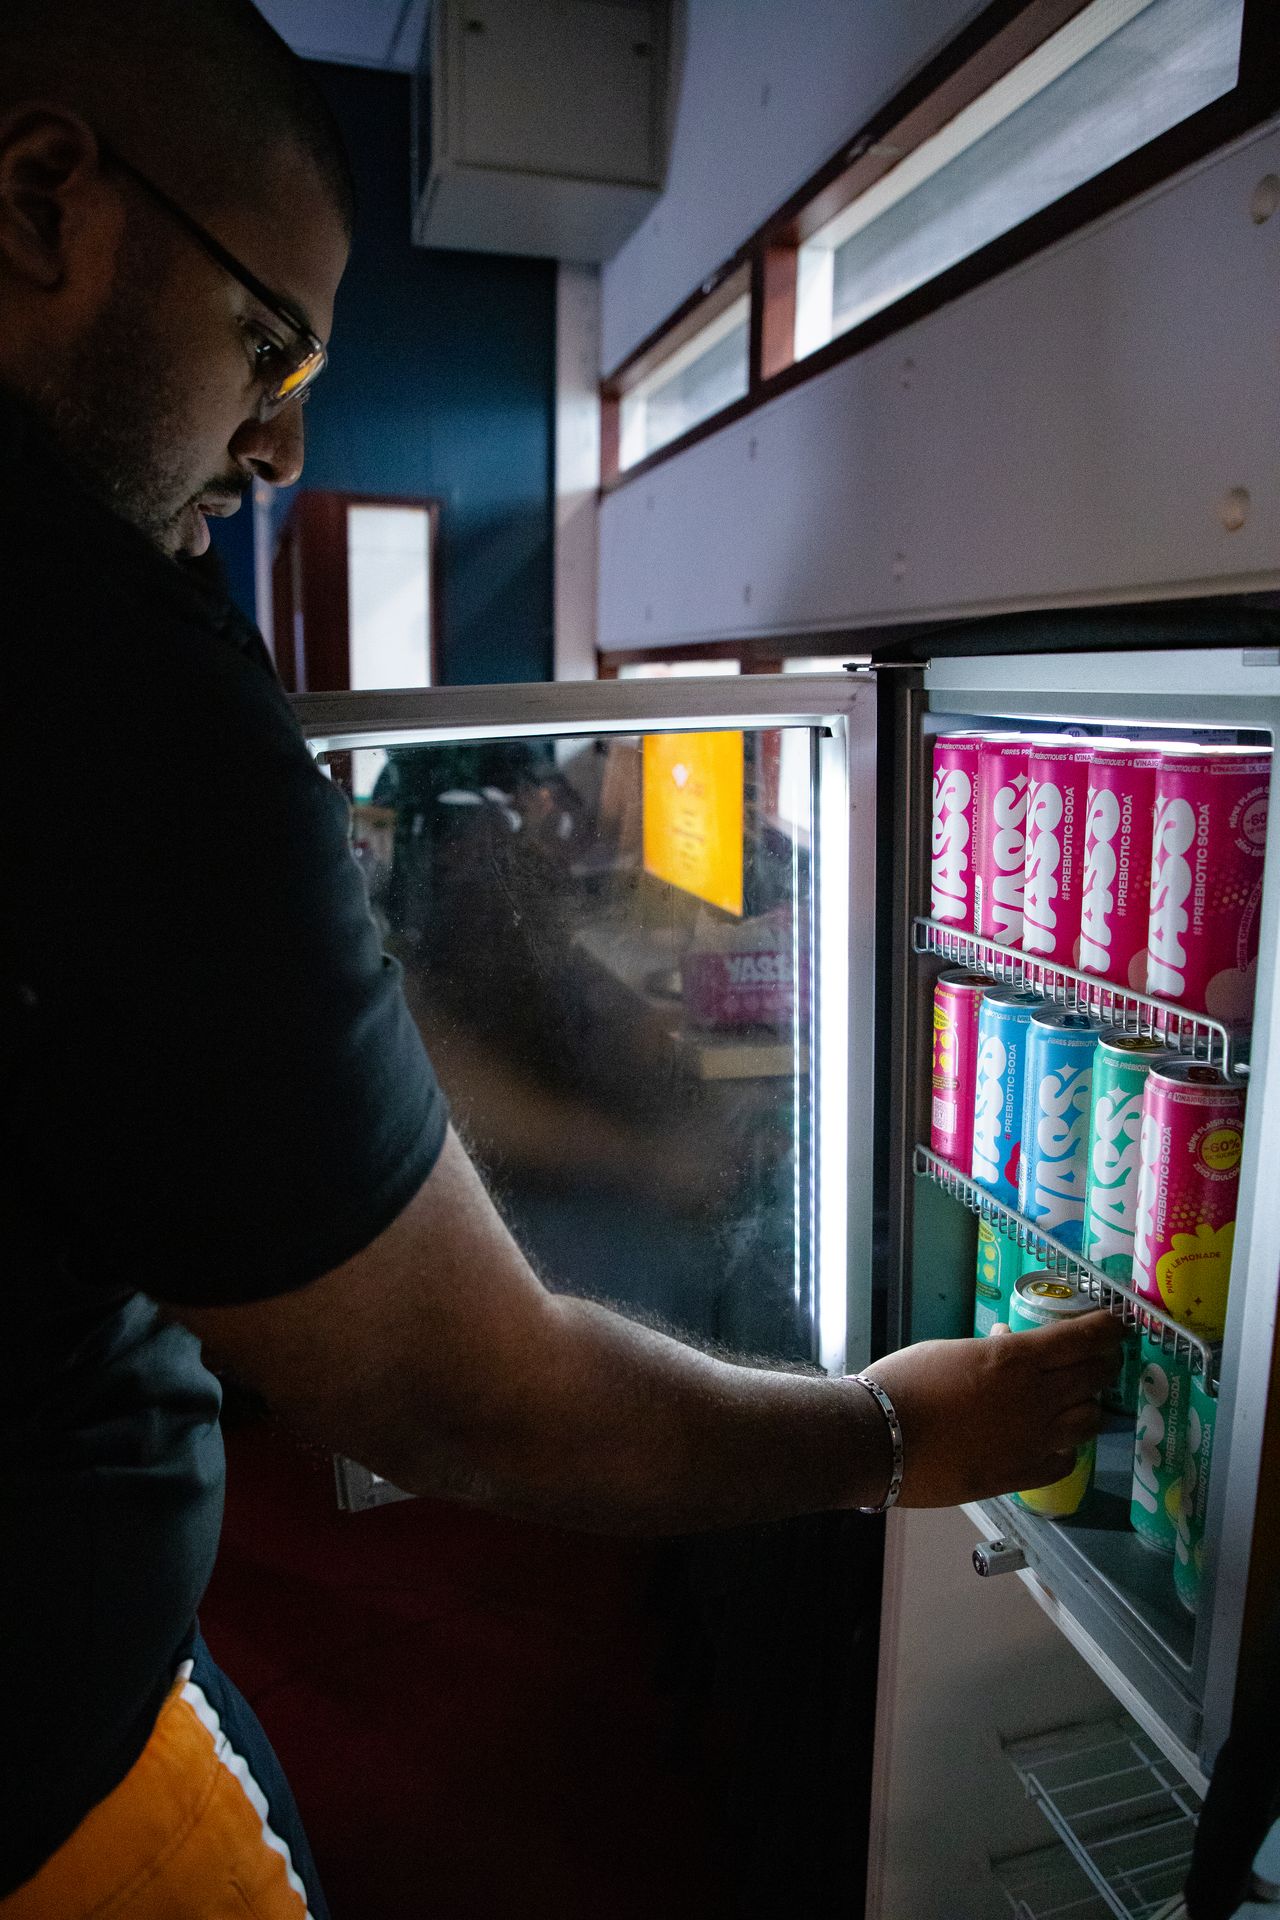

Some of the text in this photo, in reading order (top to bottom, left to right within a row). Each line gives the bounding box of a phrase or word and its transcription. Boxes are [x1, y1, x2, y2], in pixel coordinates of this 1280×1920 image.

[1062, 786, 1075, 901] #PREBIOTIC SODA
[1117, 793, 1134, 917] #PREBIOTIC SODA
[1193, 802, 1211, 936] #PREBIOTIC SODA
[1004, 1043, 1017, 1140] #PREBIOTIC SODA
[1035, 1067, 1093, 1231] YASS
[1089, 1094, 1144, 1262] YASS
[1155, 1125, 1172, 1243] #PREBIOTIC SODA
[1165, 1251, 1221, 1294] PINKY LEMONADE
